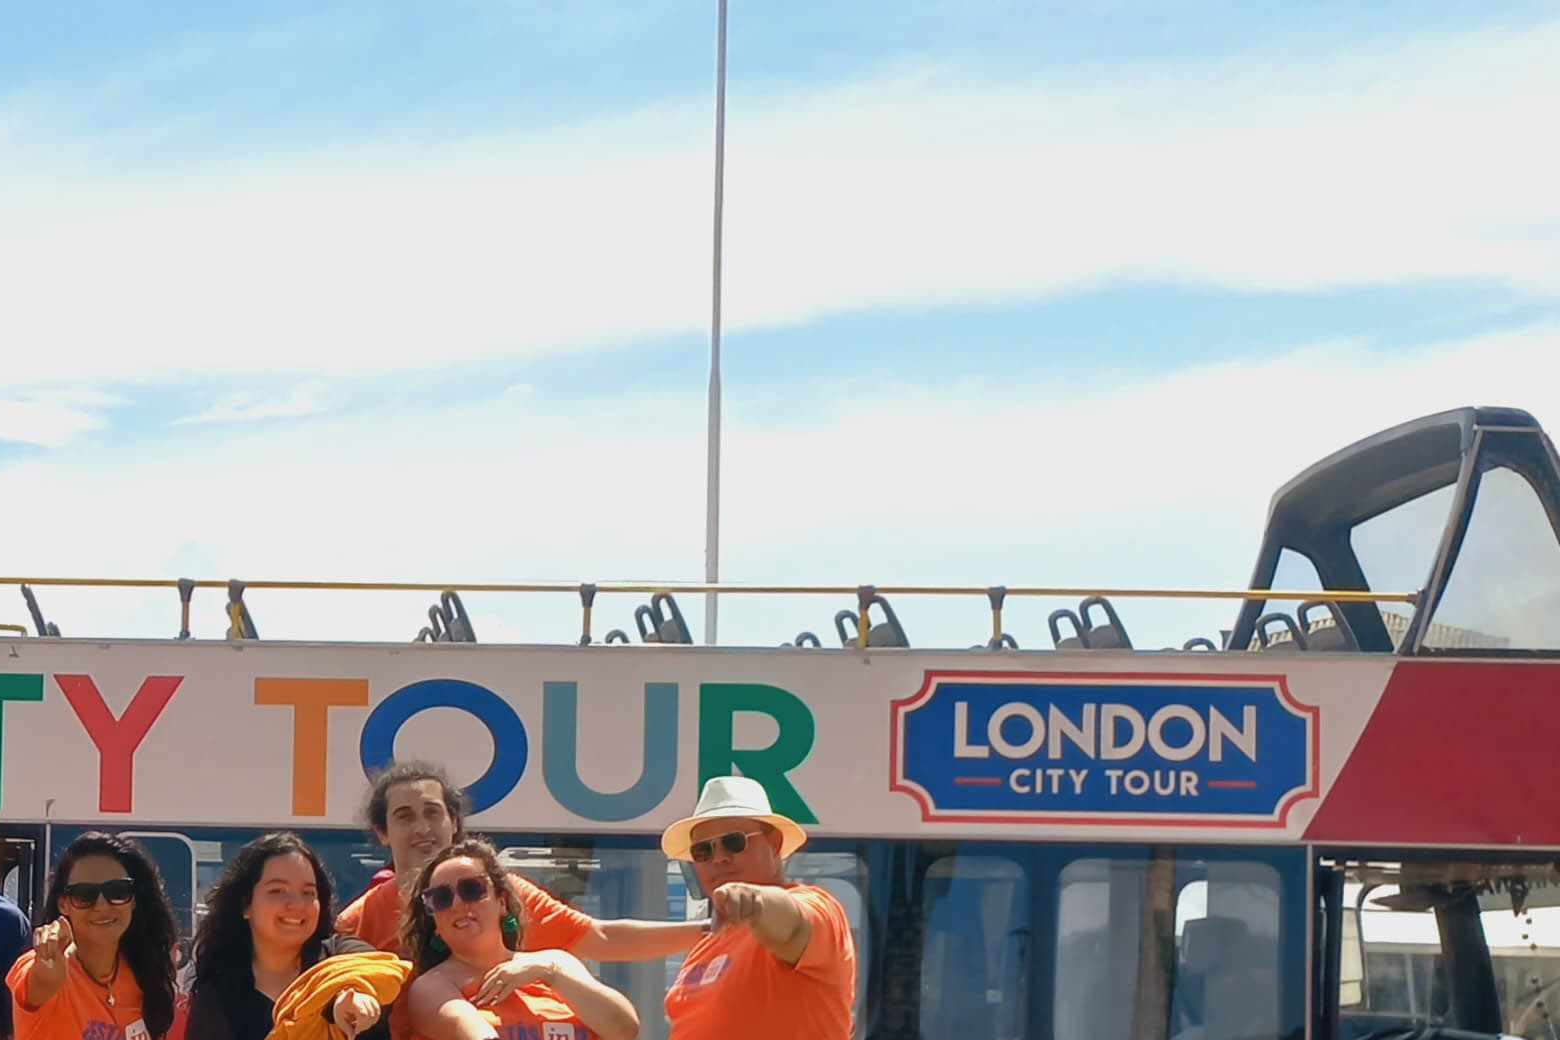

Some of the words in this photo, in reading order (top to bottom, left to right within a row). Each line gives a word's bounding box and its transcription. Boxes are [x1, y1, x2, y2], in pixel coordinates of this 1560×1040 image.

[254, 677, 820, 825] TOUR
[953, 701, 1257, 763] LONDON
[1009, 768, 1089, 795] CITY
[1104, 769, 1200, 797] TOUR
